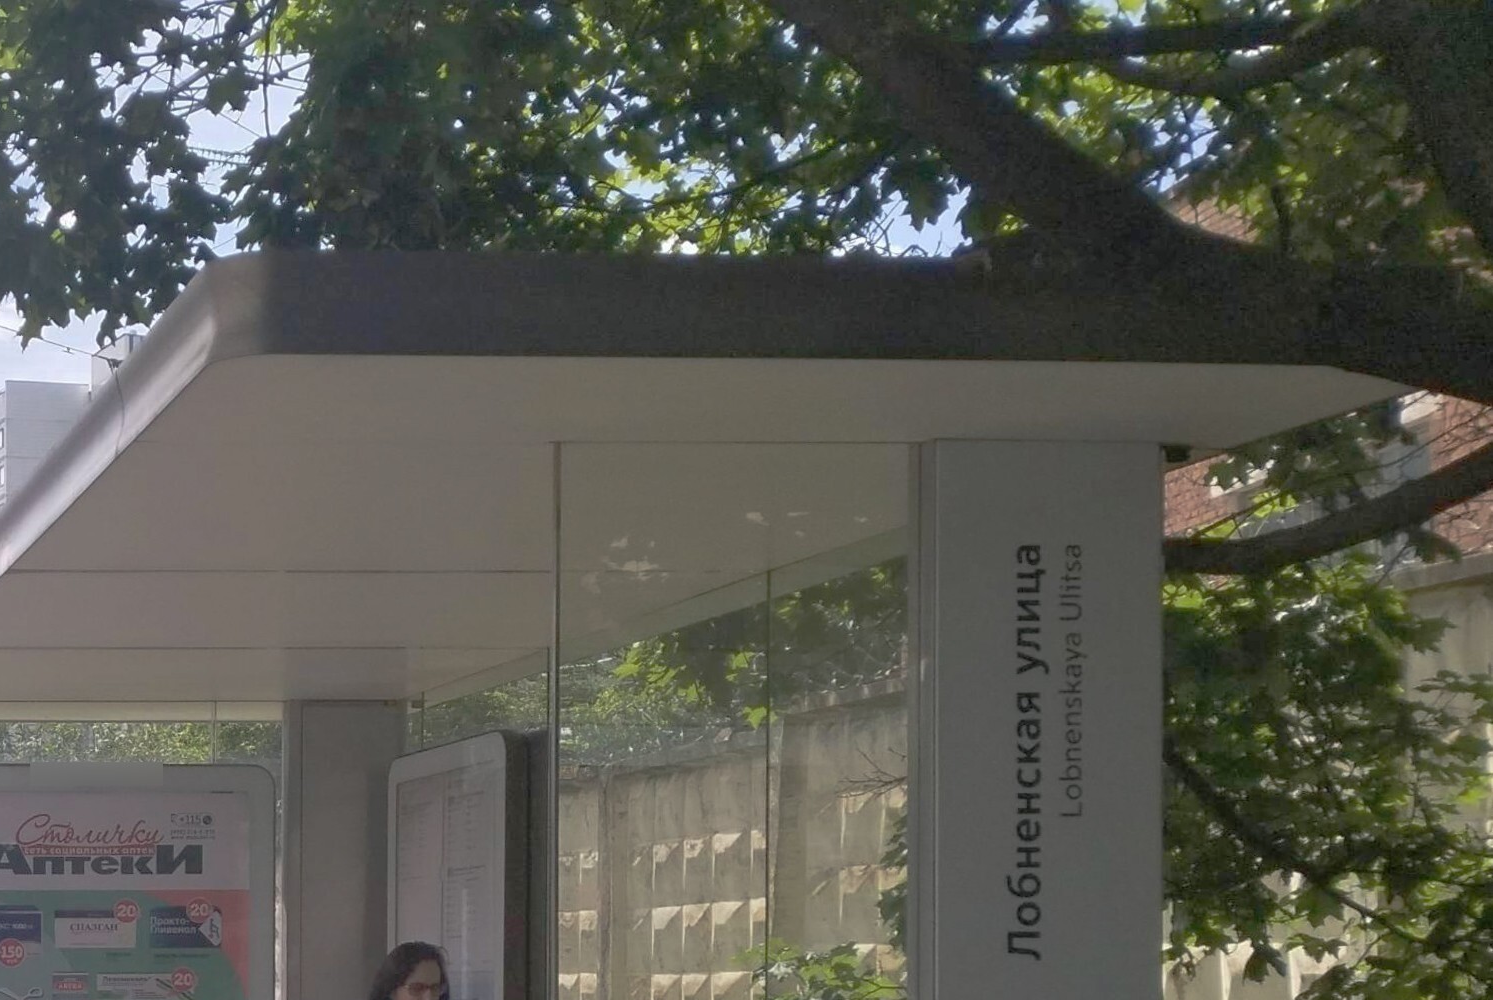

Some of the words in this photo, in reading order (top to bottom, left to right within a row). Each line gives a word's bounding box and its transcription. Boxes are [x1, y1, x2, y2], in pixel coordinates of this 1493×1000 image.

[1016, 543, 1049, 674] улица
[1058, 543, 1083, 621] Ulitsa
[1058, 632, 1087, 817] Lobnenskaya
[16, 813, 163, 845] Столички
[24, 847, 47, 855] сеть
[50, 847, 119, 855] социальных
[121, 847, 155, 855] аптек
[1007, 692, 1042, 961] Лобненская
[70, 923, 118, 931] СПАЗГАН
